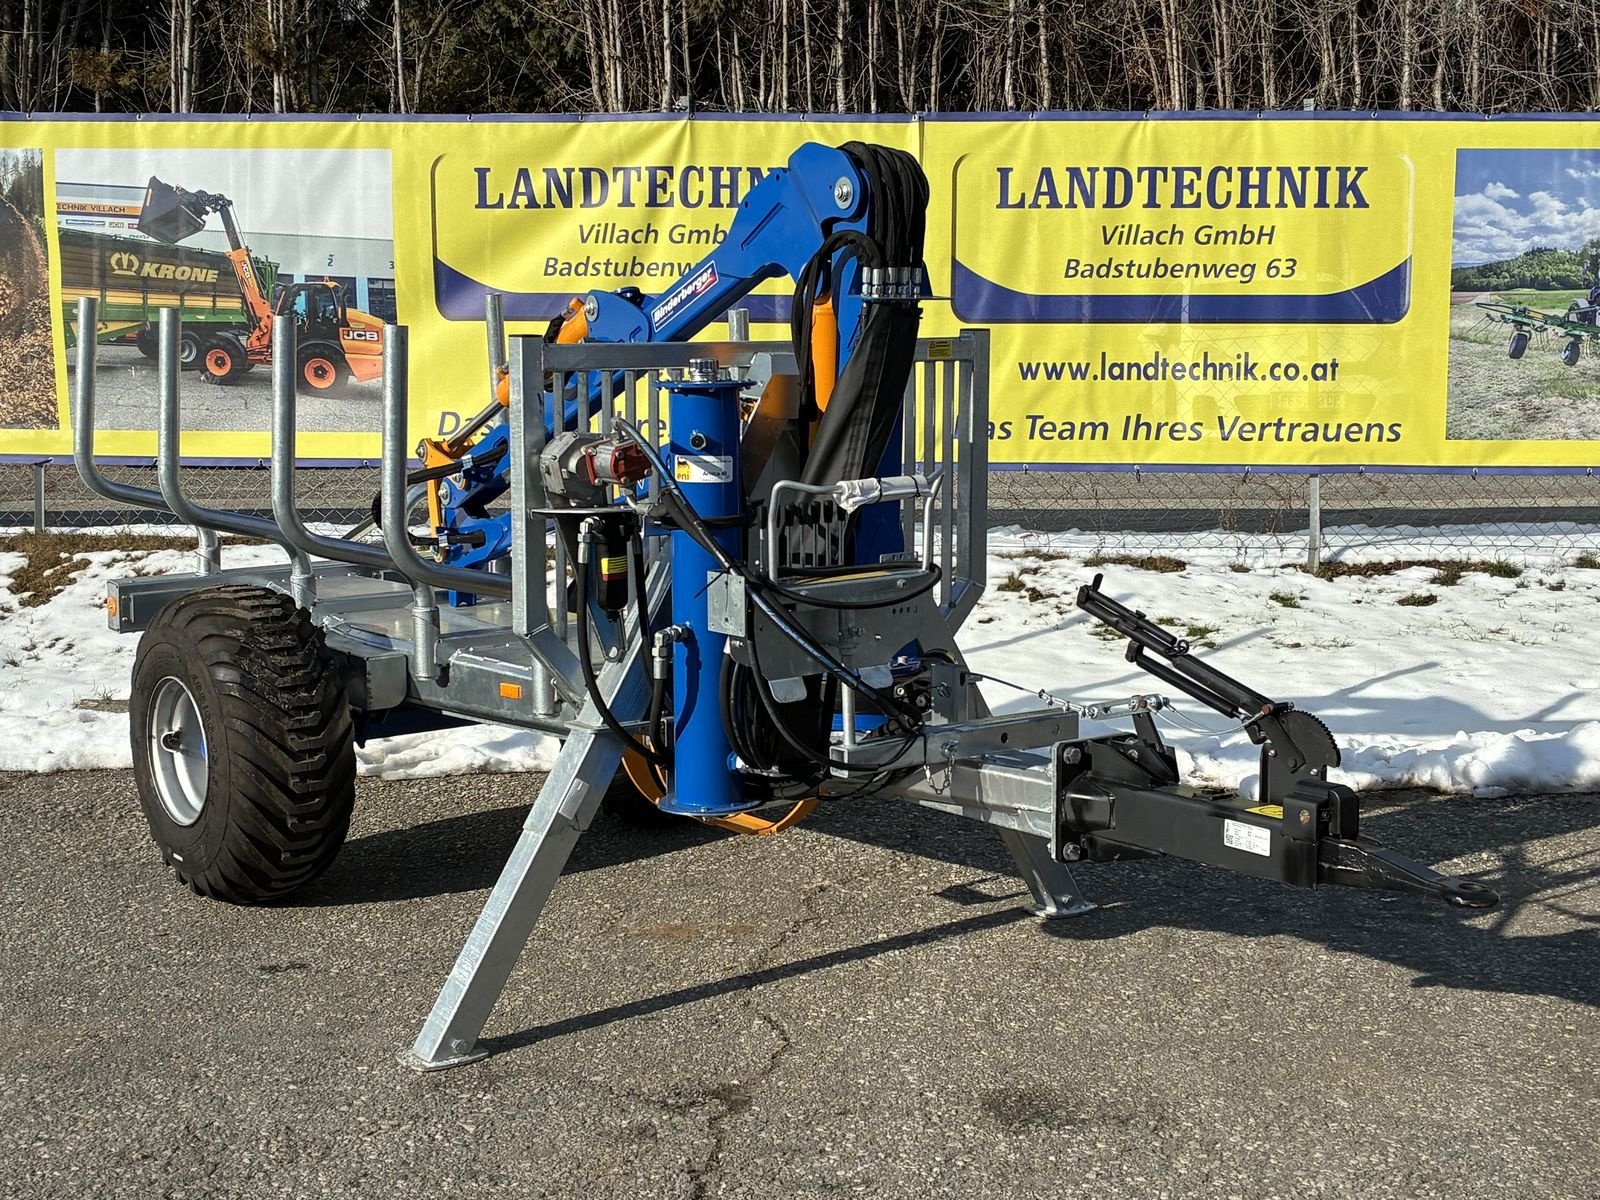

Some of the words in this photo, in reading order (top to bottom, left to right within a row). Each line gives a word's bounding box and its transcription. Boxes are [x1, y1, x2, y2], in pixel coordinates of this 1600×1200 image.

[995, 165, 1370, 210] LANDTECHNIK
[90, 204, 126, 213] VILLACH
[579, 222, 659, 245] Villach
[1101, 223, 1183, 246] Villach
[1193, 224, 1276, 246] GmbH
[140, 262, 219, 283] KRONE
[1064, 256, 1255, 285] Badstubenweg
[1265, 258, 1298, 280] 63
[653, 266, 712, 323] Binderberger
[343, 330, 379, 341] JCB
[1018, 351, 1339, 382] www.landtechnik.co.at
[437, 411, 496, 437] Ds
[1025, 415, 1109, 441] Team
[1121, 415, 1204, 442] Ihres
[1217, 416, 1402, 443] Vertrauens
[677, 471, 690, 480] eni
